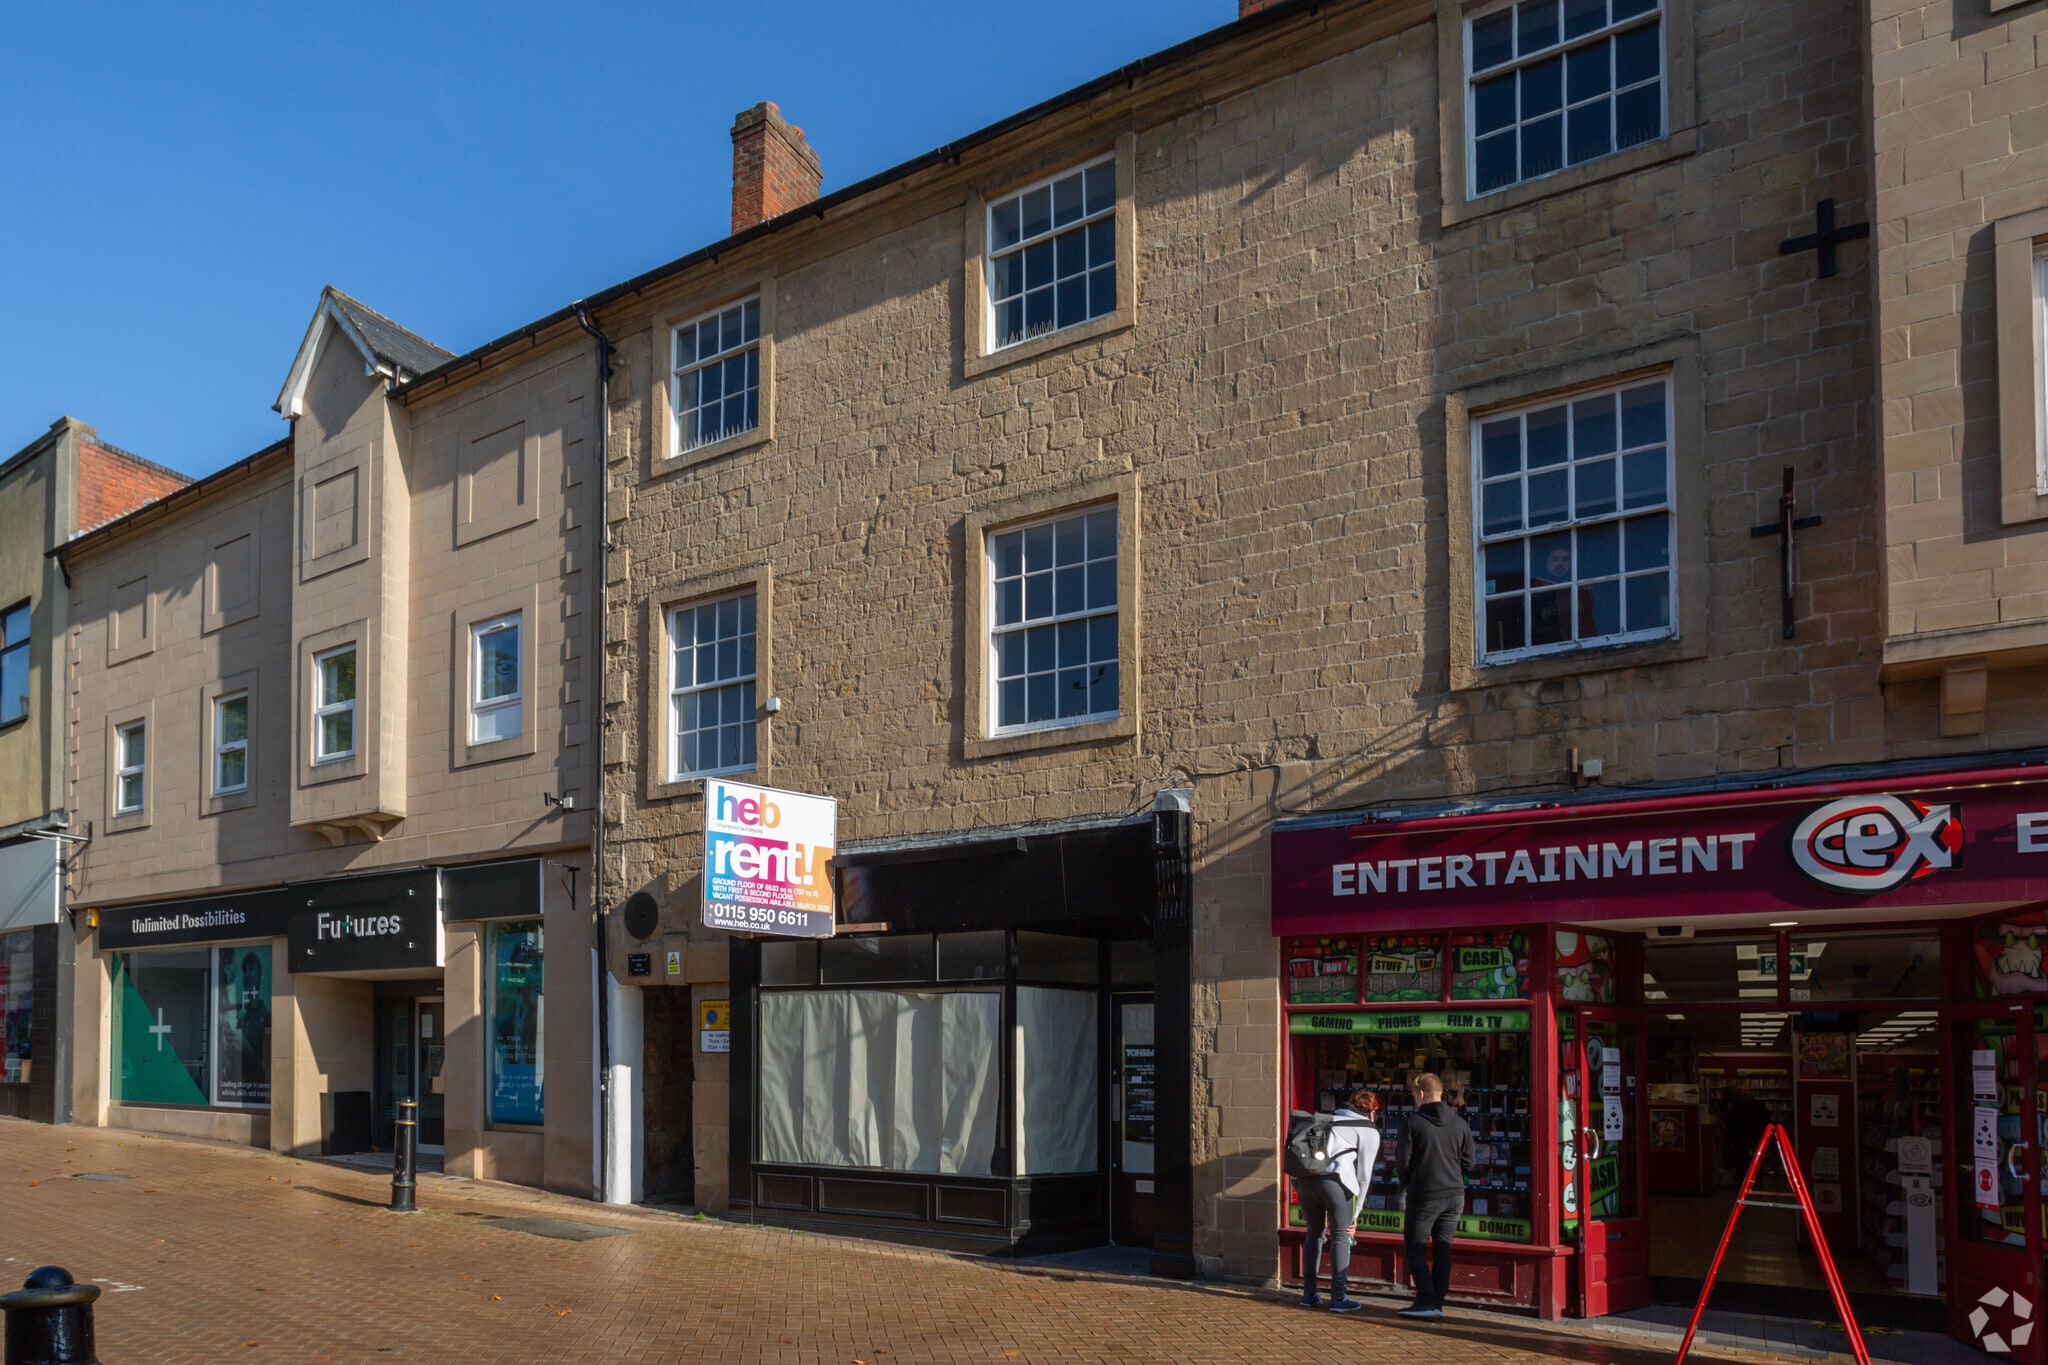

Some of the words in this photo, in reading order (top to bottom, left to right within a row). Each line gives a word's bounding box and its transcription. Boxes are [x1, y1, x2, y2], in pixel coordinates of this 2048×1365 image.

[717, 785, 781, 829] heb
[716, 822, 740, 832] chartered
[740, 825, 764, 835] surveyors
[715, 839, 815, 886] rent!
[1332, 832, 1756, 896] ENTERTAINMENT
[712, 878, 736, 887] GROUND
[737, 880, 755, 889] FLOOR
[780, 886, 787, 894] sq
[805, 890, 812, 898] sq
[712, 884, 727, 893] WITH
[728, 886, 743, 895] FIRST
[744, 888, 748, 896] &
[750, 889, 771, 899] SECOND
[712, 891, 733, 900] VACANT
[735, 894, 768, 904] POSSESSION
[769, 898, 796, 907] AVAILABLE
[797, 901, 816, 910] MARCH
[817, 904, 830, 912] 2020
[132, 914, 179, 934] Unlimited
[182, 909, 246, 929] Possibilities
[714, 903, 746, 920] 0115
[749, 906, 776, 923] 950
[778, 911, 808, 927] 6611
[714, 918, 771, 931] www.heb.co.uk
[1325, 961, 1343, 973] BUY
[1374, 960, 1403, 972] STUFF
[1419, 958, 1432, 970] for
[1463, 951, 1500, 967] CASH
[1291, 960, 1315, 978] WE
[1311, 1015, 1353, 1030] GAMING
[1378, 1014, 1421, 1030] PHONES
[1447, 1014, 1472, 1028] FILM
[1475, 1016, 1484, 1028] &
[1486, 1015, 1503, 1029] TV
[1590, 1160, 1616, 1191] ASH
[1478, 1220, 1525, 1237] DONATE
